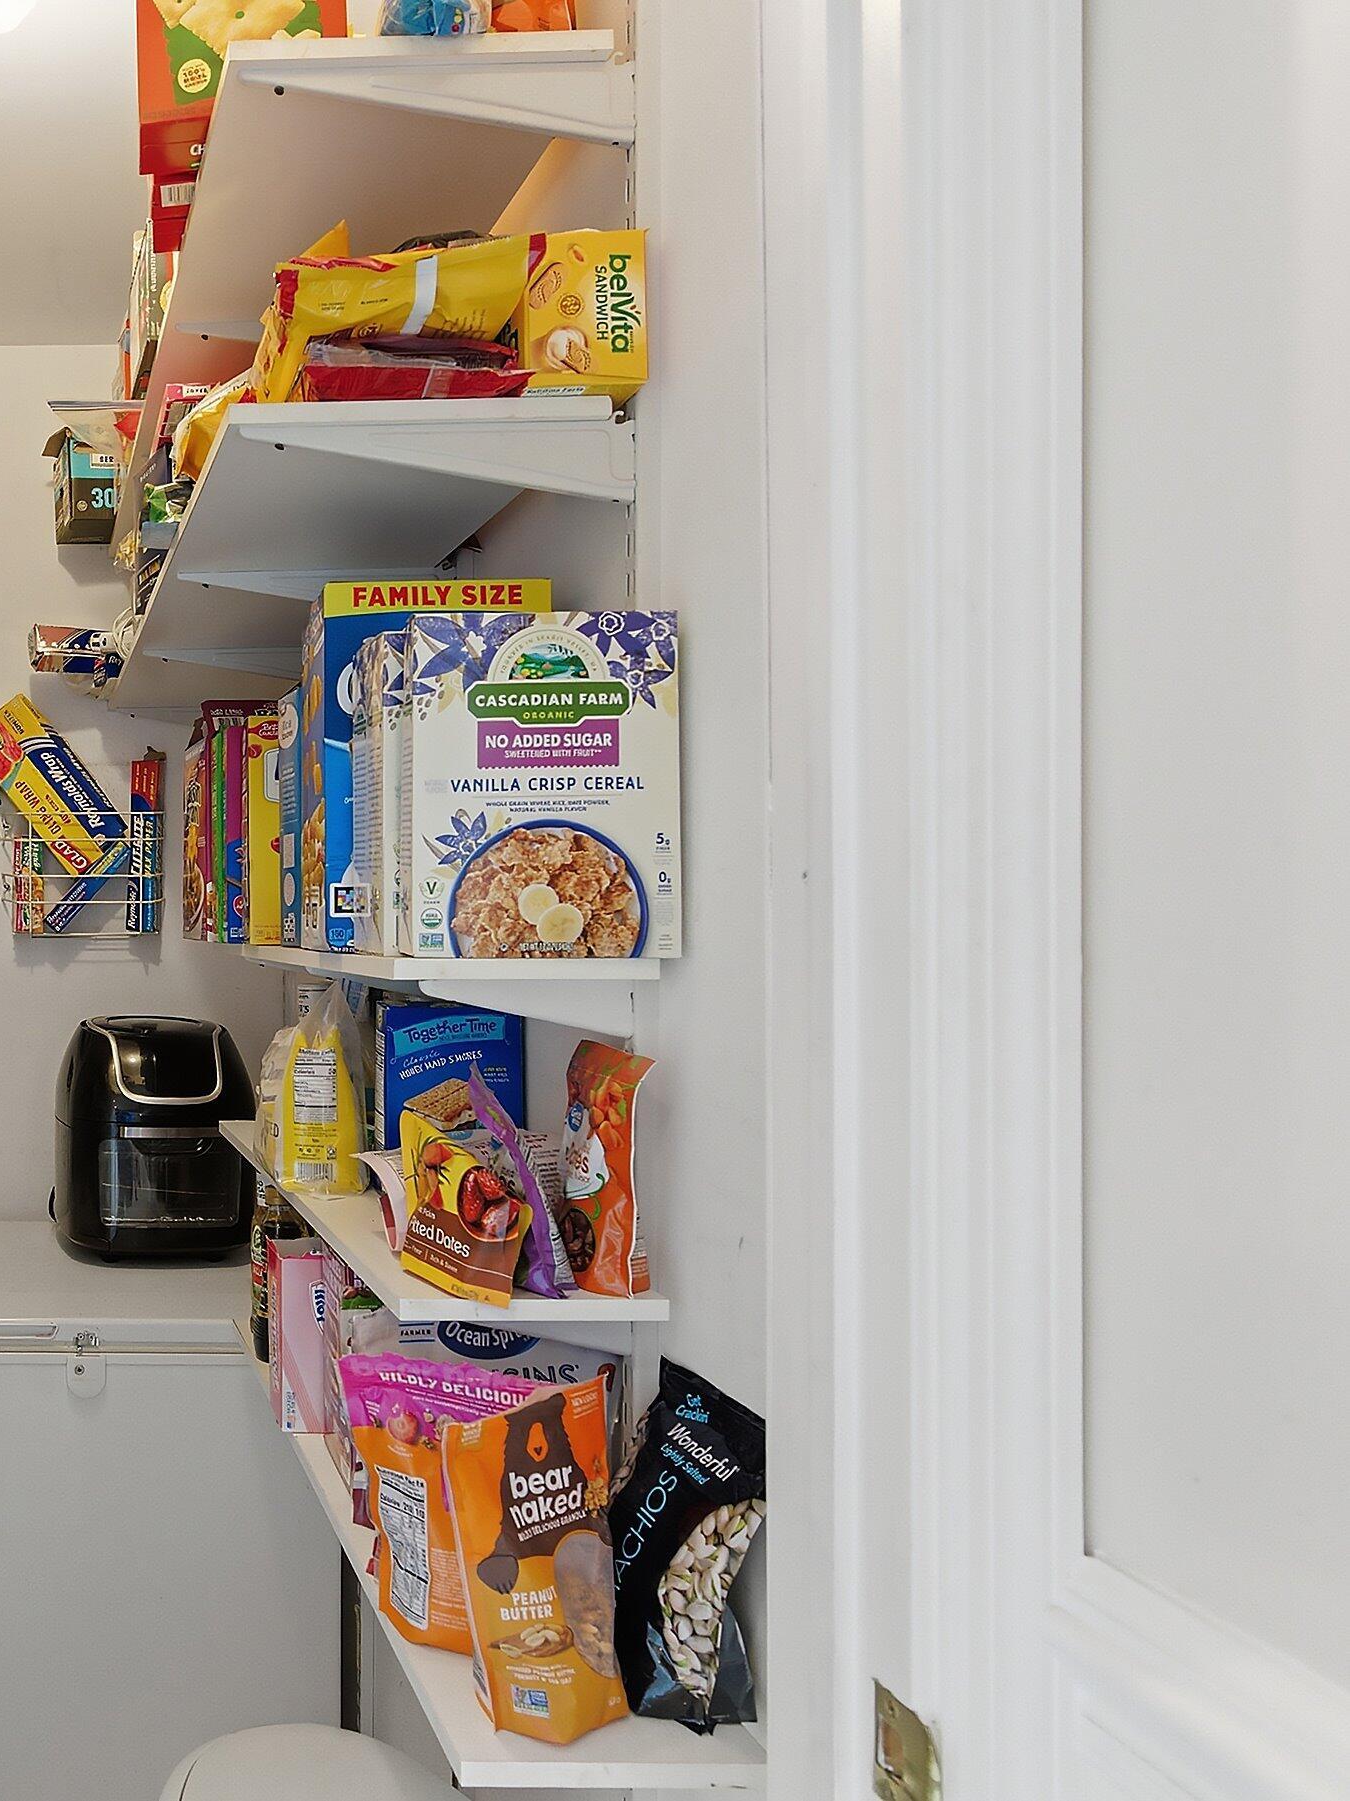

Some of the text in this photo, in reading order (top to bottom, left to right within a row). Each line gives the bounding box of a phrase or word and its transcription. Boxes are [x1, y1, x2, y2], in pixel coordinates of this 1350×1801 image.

[595, 265, 609, 341] SANDWICH
[609, 254, 641, 353] belVita
[91, 486, 115, 509] 30
[352, 584, 523, 607] FAMILY SIZE
[475, 692, 623, 707] CASCADIAN FARM
[522, 710, 575, 720] ORGANIC
[485, 732, 613, 749] NO ADDED SUGAR
[552, 749, 572, 758] WITH
[40, 751, 65, 785] Wrap
[14, 780, 41, 809] WRAP
[451, 776, 644, 792] VANILLA CRISP CEREAL
[54, 838, 89, 870] GLAD
[403, 1019, 467, 1044] Together
[465, 1017, 497, 1034] Time
[399, 1064, 424, 1081] HONEY
[425, 1057, 446, 1071] MAID
[436, 1228, 471, 1259] Dates
[446, 1321, 490, 1348] Ocean
[379, 1370, 438, 1389] WILDLY
[660, 1443, 711, 1485] Lightly Salted
[667, 1422, 738, 1482] Wonderful
[509, 1464, 573, 1500] bear
[508, 1482, 584, 1529] naked
[614, 1470, 679, 1592] ACHIOS
[511, 1585, 558, 1606] PEANUT
[500, 1606, 554, 1622] BUTTER
